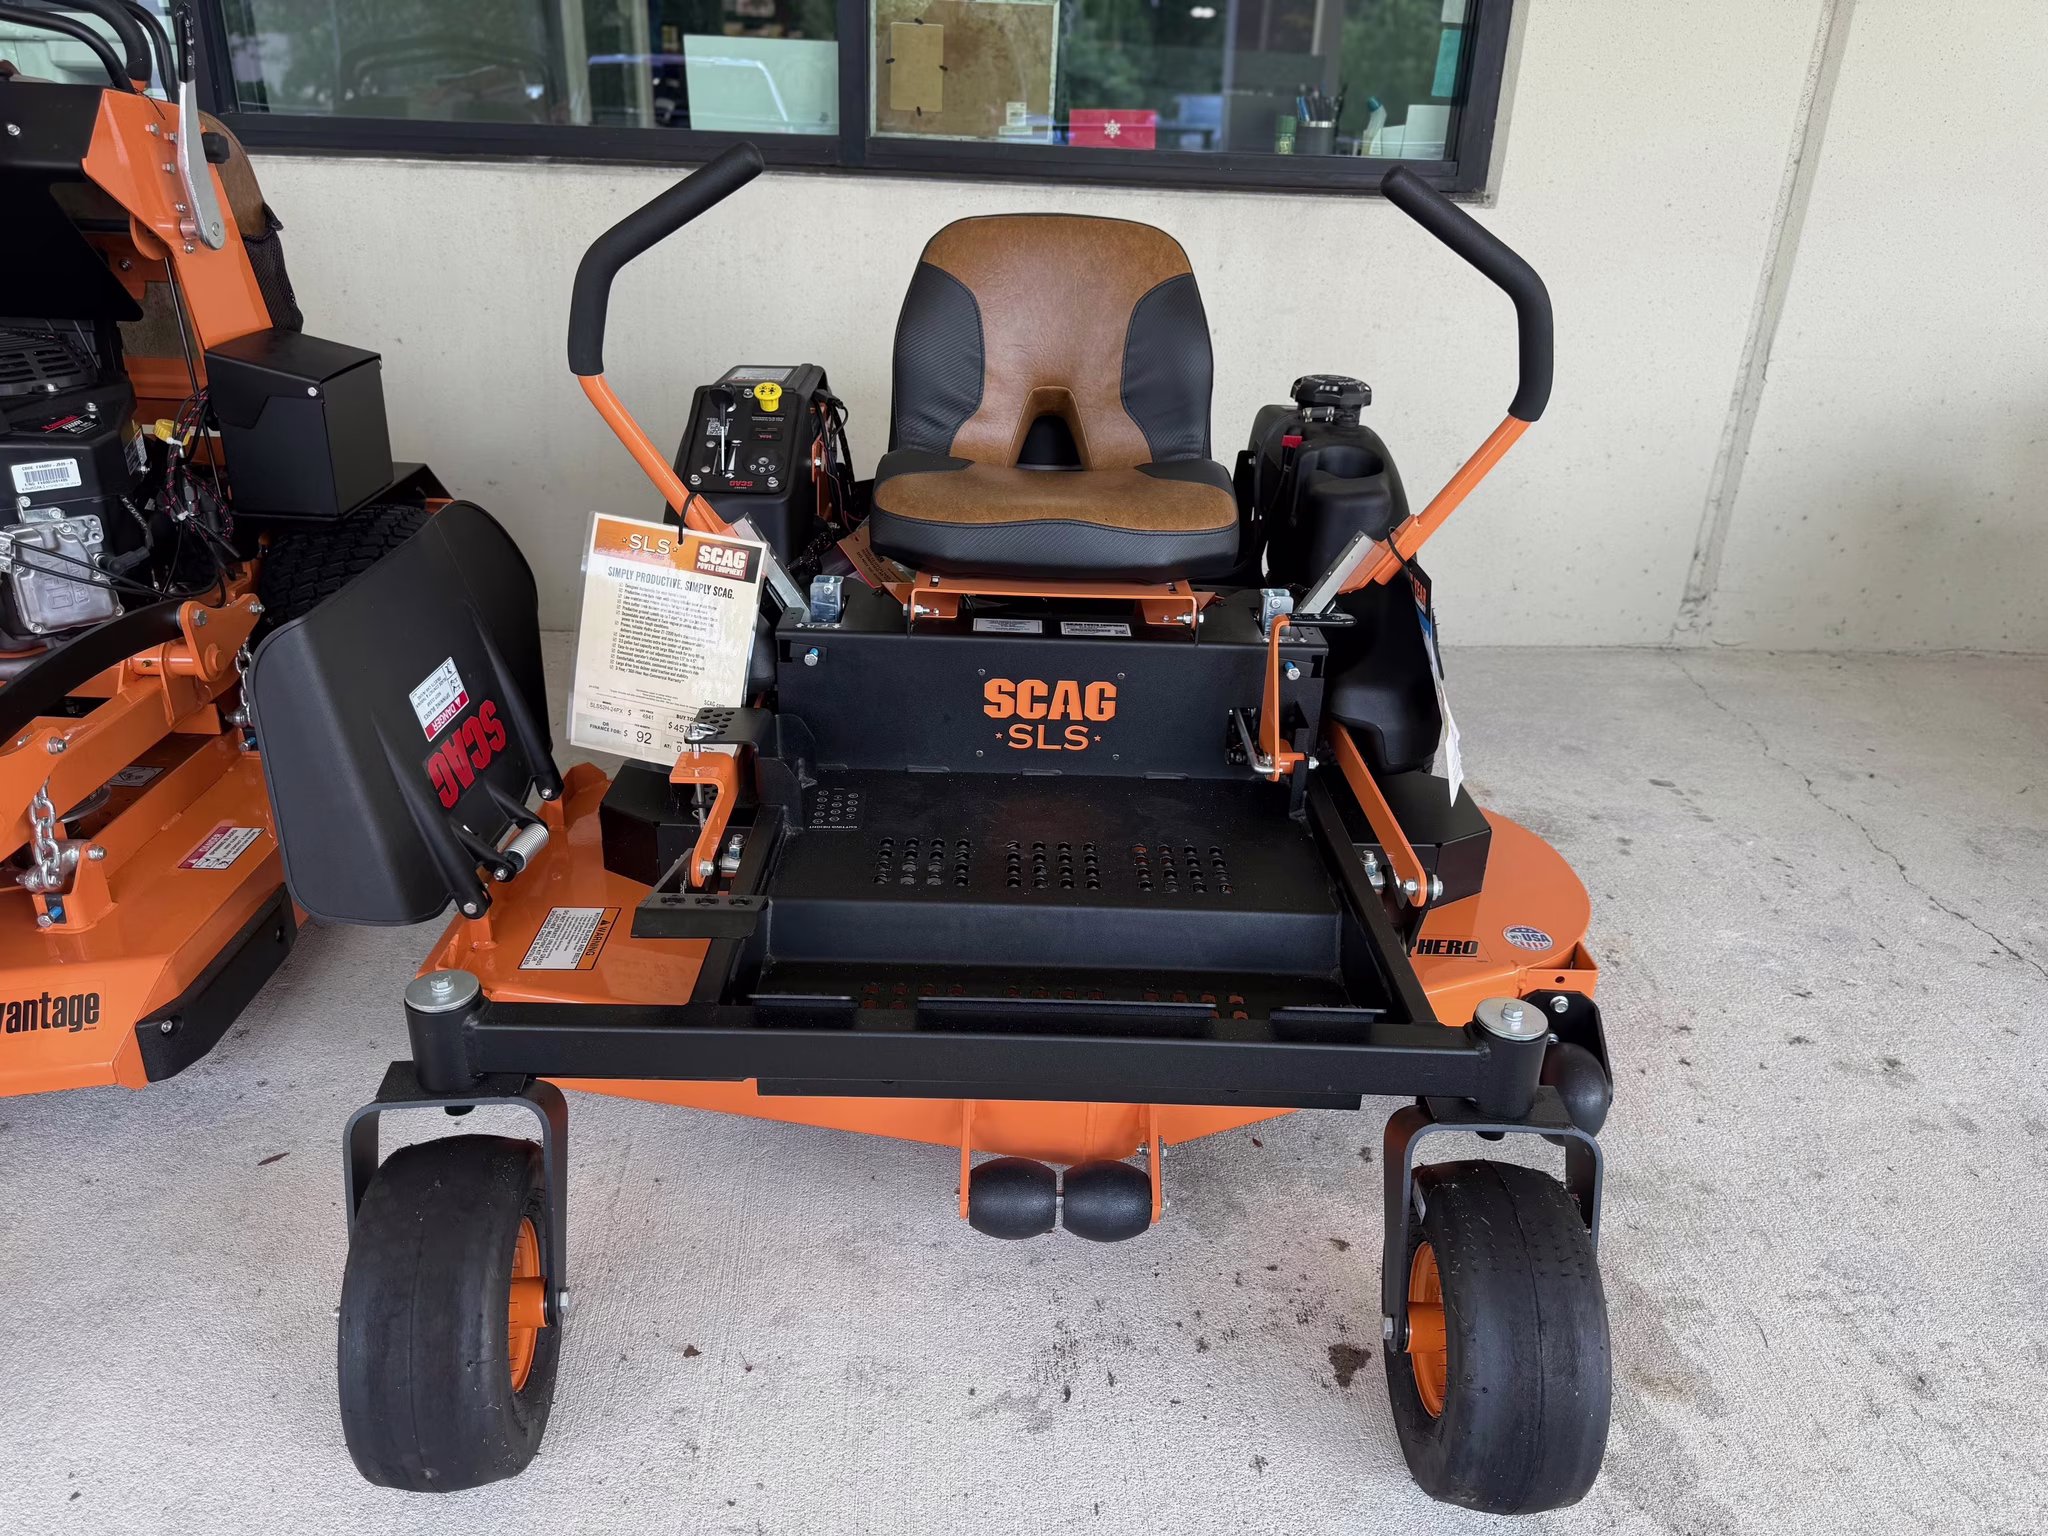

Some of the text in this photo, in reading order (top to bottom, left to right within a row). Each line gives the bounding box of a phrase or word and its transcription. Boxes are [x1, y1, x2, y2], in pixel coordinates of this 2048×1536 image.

[629, 533, 670, 554] SLS
[698, 545, 747, 569] SCAG
[696, 561, 743, 577] POWER EQUIPMENT
[607, 566, 734, 599] SIMPLY PRODUCTIVE. SIMPLY SCAG.
[423, 691, 450, 720] SPINNING BLADES
[983, 677, 1118, 722] SCAG
[431, 702, 456, 731] DANGER
[589, 723, 609, 732] FINANCE
[668, 721, 672, 729] $
[623, 729, 652, 745] $ 92
[1007, 723, 1090, 751] SLS
[427, 699, 507, 808] SCAG
[580, 929, 592, 943] BLADES
[584, 926, 607, 955] WARNING
[1416, 939, 1479, 955] HERO
[1522, 933, 1551, 943] USA
